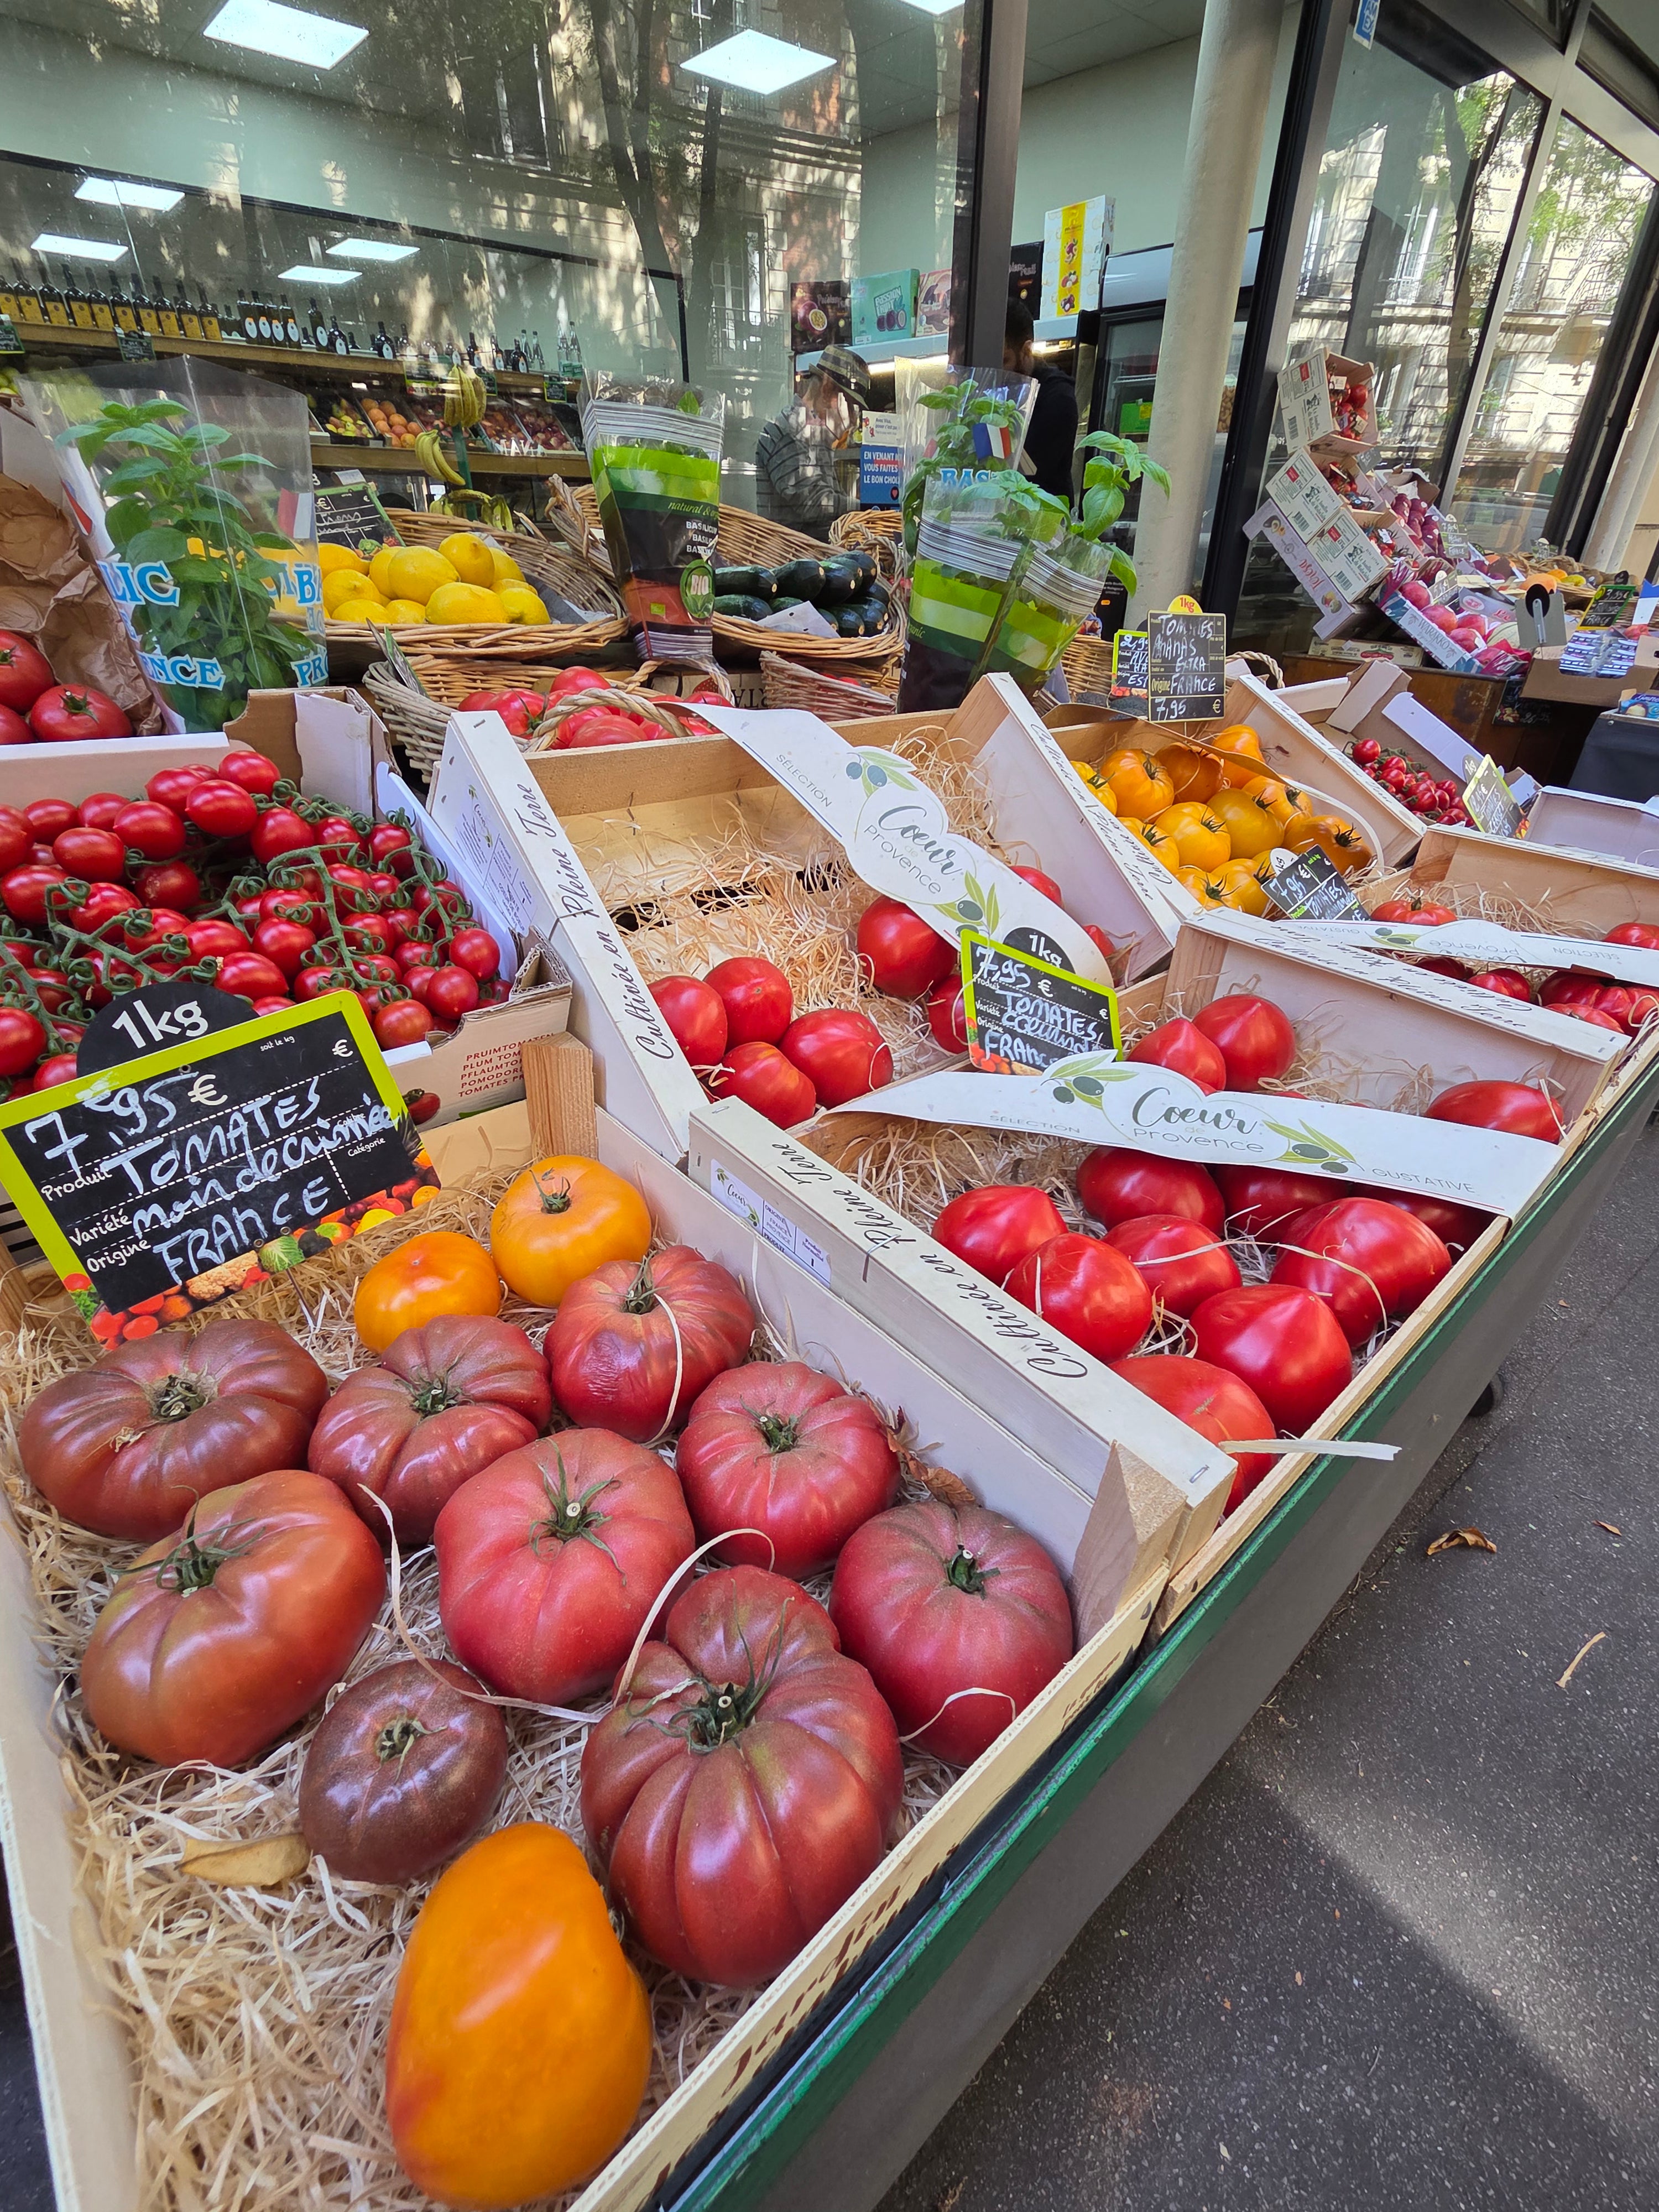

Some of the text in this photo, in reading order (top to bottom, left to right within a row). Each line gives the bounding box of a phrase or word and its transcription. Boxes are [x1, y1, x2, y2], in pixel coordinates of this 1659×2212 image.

[864, 451, 894, 461] EN VENANT
[864, 463, 898, 472] VOUS FAITES
[872, 476, 883, 484] BON
[317, 498, 331, 510] €
[668, 502, 702, 514] natural
[703, 505, 711, 517] &
[691, 575, 709, 596] BIO
[1180, 597, 1195, 613] 1kg
[1151, 673, 1216, 695] Origine FRANCE
[1155, 698, 1222, 721] 7,95 €
[1465, 759, 1477, 775] 1kg
[1298, 864, 1311, 879] €
[1269, 873, 1307, 906] 7,95
[1305, 878, 1342, 919] TOMATES
[515, 783, 674, 1061] Cultivée en Pleine Terre
[1029, 934, 1063, 969] 1kg
[976, 946, 1053, 998] 7,95 €
[975, 1000, 1001, 1017] Variété
[995, 989, 1098, 1041] TOMATES
[1099, 1008, 1109, 1020] €
[112, 1000, 208, 1048] 1kg
[977, 1016, 1004, 1034] Origine
[260, 1035, 295, 1052] soit le kg
[332, 1039, 353, 1057] €
[466, 1033, 554, 1062] PRUIMTOMT
[462, 1058, 493, 1072] PLUM
[458, 1078, 508, 1098] TOMATES
[25, 1072, 228, 1176] 7,95 €
[41, 1075, 321, 1201] Produit TOMATES
[347, 1137, 386, 1157] Catégorie
[1371, 1167, 1478, 1196] GUSTATIVE
[69, 1208, 132, 1247] Variété
[86, 1176, 331, 1286] Origine FRANCE
[771, 1142, 1088, 1379] Cultivée en Pleine Terre
